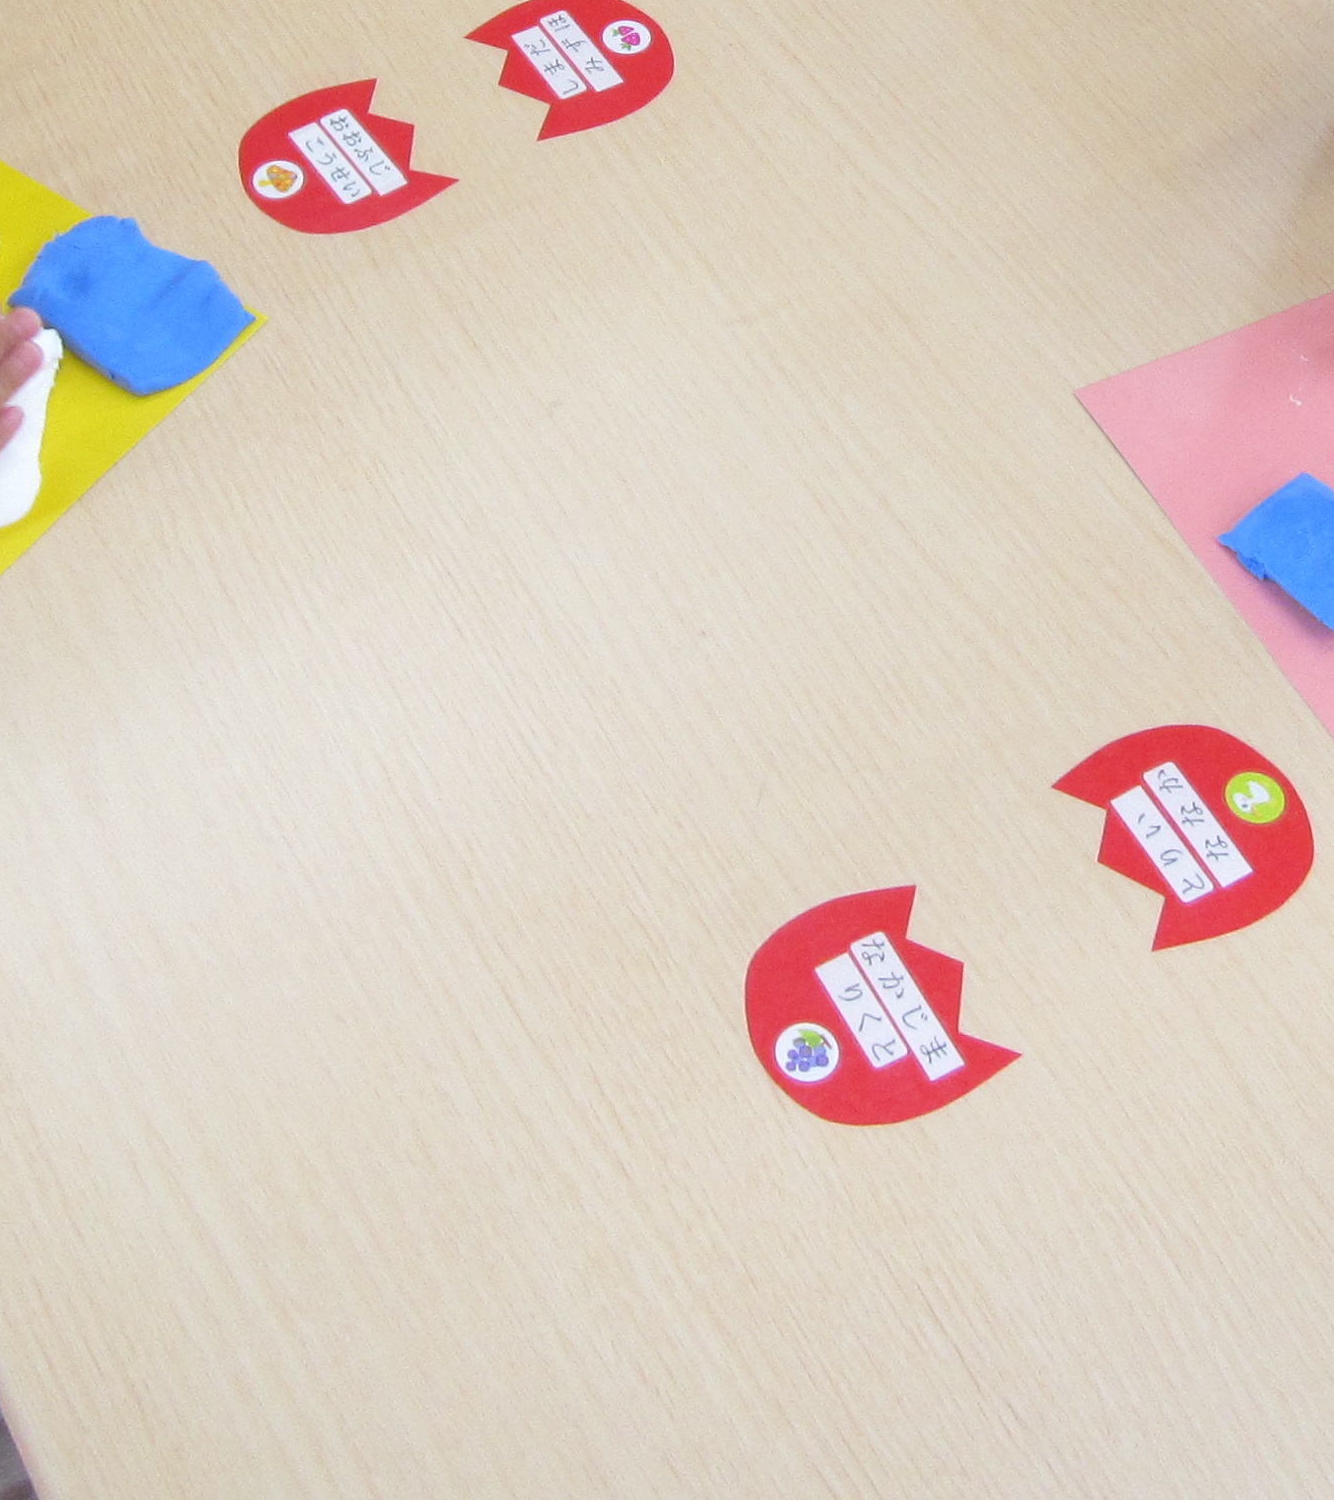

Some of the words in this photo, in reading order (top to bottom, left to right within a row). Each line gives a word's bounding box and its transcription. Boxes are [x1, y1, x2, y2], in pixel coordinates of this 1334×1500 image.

[523, 38, 582, 95] しまだ
[547, 15, 606, 76] みずほ
[306, 138, 361, 198] こうせい
[329, 114, 393, 177] おおふじ
[1155, 767, 1231, 862] ななか
[1135, 811, 1206, 895] とりい
[837, 981, 897, 1063] りくと
[860, 938, 949, 1064] なかじま
